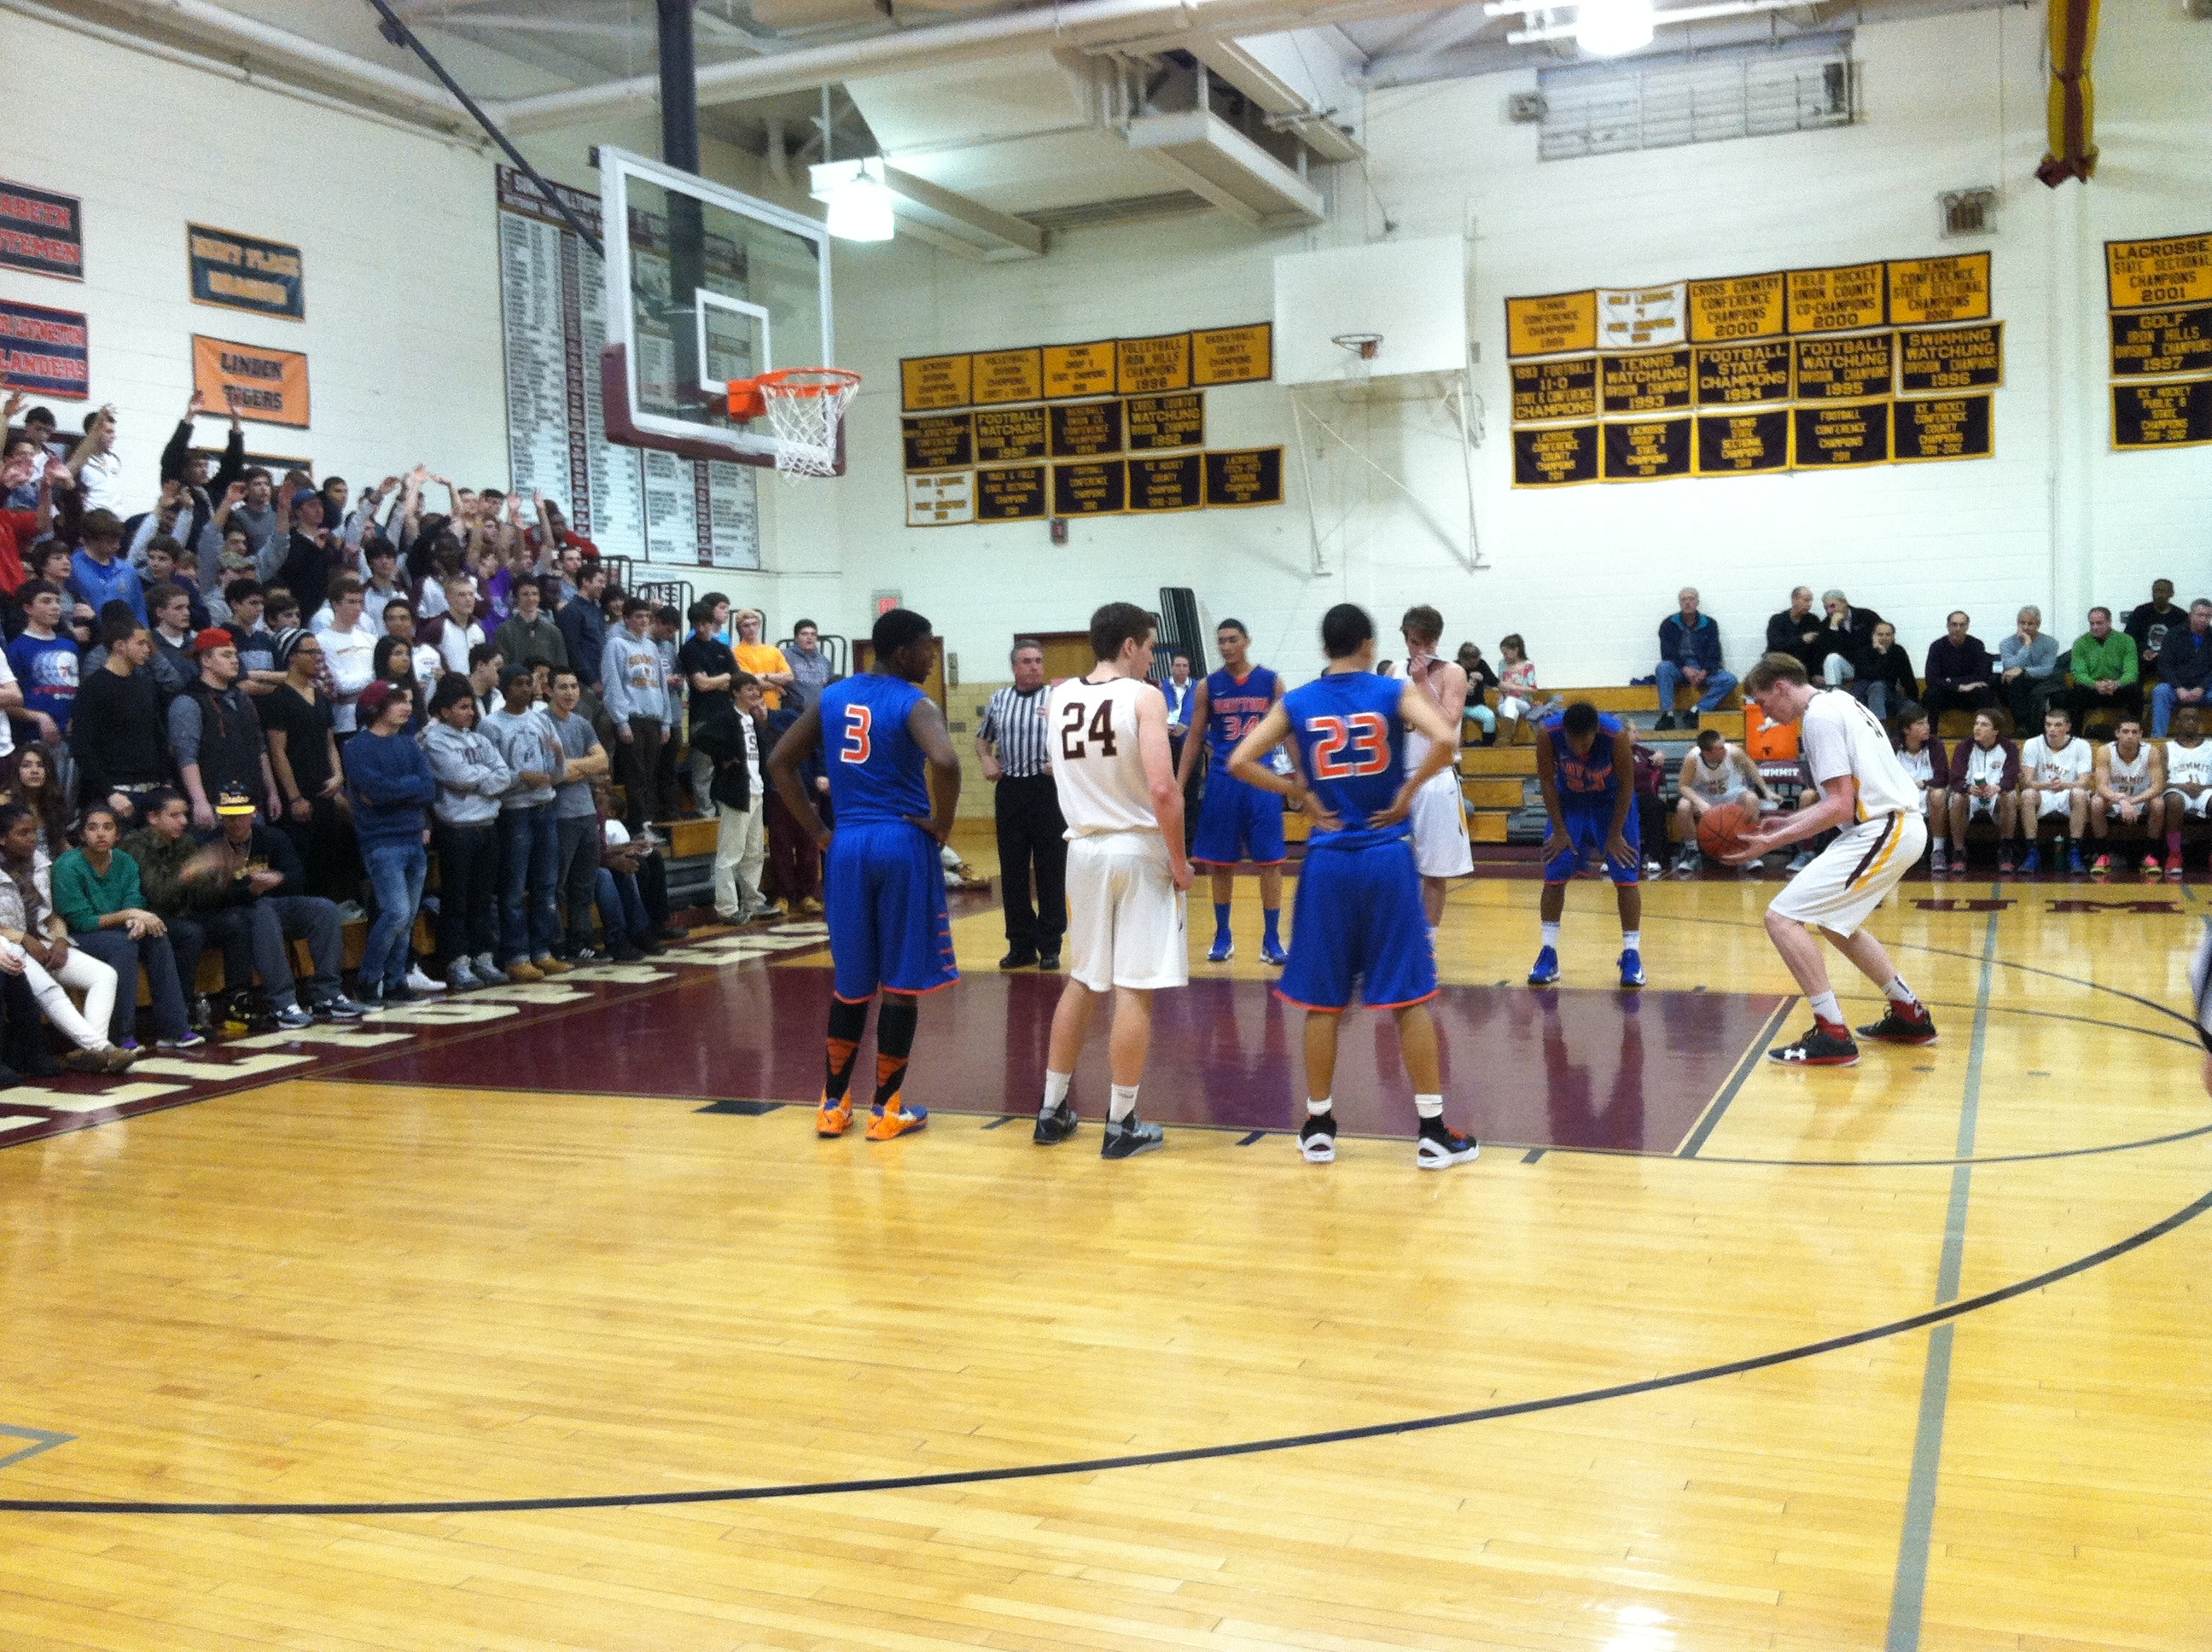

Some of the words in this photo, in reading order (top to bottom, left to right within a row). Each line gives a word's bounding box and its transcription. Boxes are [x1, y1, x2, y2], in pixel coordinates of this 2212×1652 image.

[2114, 239, 2209, 259] LACROSSE
[2114, 259, 2145, 275] STATE
[1793, 273, 1826, 286] FIELD
[1835, 267, 1877, 282] HOCKEY
[1901, 268, 1975, 285] CONFERENCE
[2129, 271, 2197, 288] CHAMPIONS
[1692, 283, 1726, 297] CROSS
[1733, 276, 1779, 293] COUNTRY
[1794, 288, 1826, 300] UNION
[1835, 282, 1877, 298] COUNTY
[1894, 285, 1921, 299] STATE
[1702, 292, 1771, 311] CONFERENCE
[2141, 287, 2185, 302] 2001
[1795, 298, 1876, 315] CO-CHAMPIONS
[1907, 295, 1970, 311] CHAMPIONS
[1708, 308, 1767, 323] CHAMPIONS
[1813, 312, 1859, 329] 2000
[2140, 313, 2187, 329] GOLF
[1528, 323, 1576, 336] CHAMPIONS
[1715, 322, 1758, 336] 2000
[2127, 330, 2155, 343] IRON
[2165, 326, 2200, 340] HILLS
[1121, 339, 1183, 352] VOLLEYBALL
[1910, 329, 1992, 347] SWIMMING
[1699, 345, 1787, 363] FOOTBALL
[1801, 339, 1889, 356] FOOTBALL
[1906, 342, 1996, 360] WATCHUNG
[1152, 352, 1179, 364] HILLS
[1208, 355, 1252, 367] CHAMPIONS
[1620, 355, 1674, 370] TENNIS
[1803, 352, 1888, 369] WATCHUNG
[1951, 356, 1997, 372] CHAMPIONS
[2143, 357, 2184, 370] 1997
[220, 352, 284, 381] LINDEN
[1126, 364, 1178, 378] CHAMPIONS
[1544, 363, 1593, 377] FOOTBALL
[1719, 360, 1768, 375] STATE
[1843, 365, 1889, 381] CHAMPIONS
[1606, 367, 1689, 384] WATCHUNG
[1701, 370, 1787, 389] CHAMPIONS
[1932, 371, 1970, 387] 1996
[1547, 387, 1593, 403] CONFERENCE
[1646, 381, 1690, 396] CHAMPIONS
[1725, 387, 1761, 401] 1994
[1826, 381, 1864, 395] 1995
[2157, 386, 2192, 398] HOCKEY
[1133, 399, 1156, 411] CROSS
[1164, 396, 1197, 409] COUNTRY
[1516, 400, 1596, 419] CHAMPIONS
[1629, 395, 1665, 410] 1993
[978, 410, 1043, 425] FOOTBALL
[1132, 408, 1201, 423] WATCHUNG
[1821, 410, 1860, 422] FOOTBALL
[1914, 412, 1968, 425] CONFERENCE
[1815, 422, 1867, 435] CONFERENCE
[2141, 418, 2189, 429] CHAMPIONS
[1533, 439, 1580, 452] CONFERENCE
[1819, 436, 1864, 449] CHAMPIONS
[1918, 433, 1964, 445] CHAMPIONS
[1627, 454, 1668, 466] CHAMPIONS
[1722, 446, 1765, 459] CHAMPIONS
[1537, 460, 1576, 471] CHAMPIONS
[841, 703, 873, 765] 3
[1062, 699, 1118, 760] 24
[1223, 715, 1260, 741] 34
[1307, 712, 1392, 780] 23
